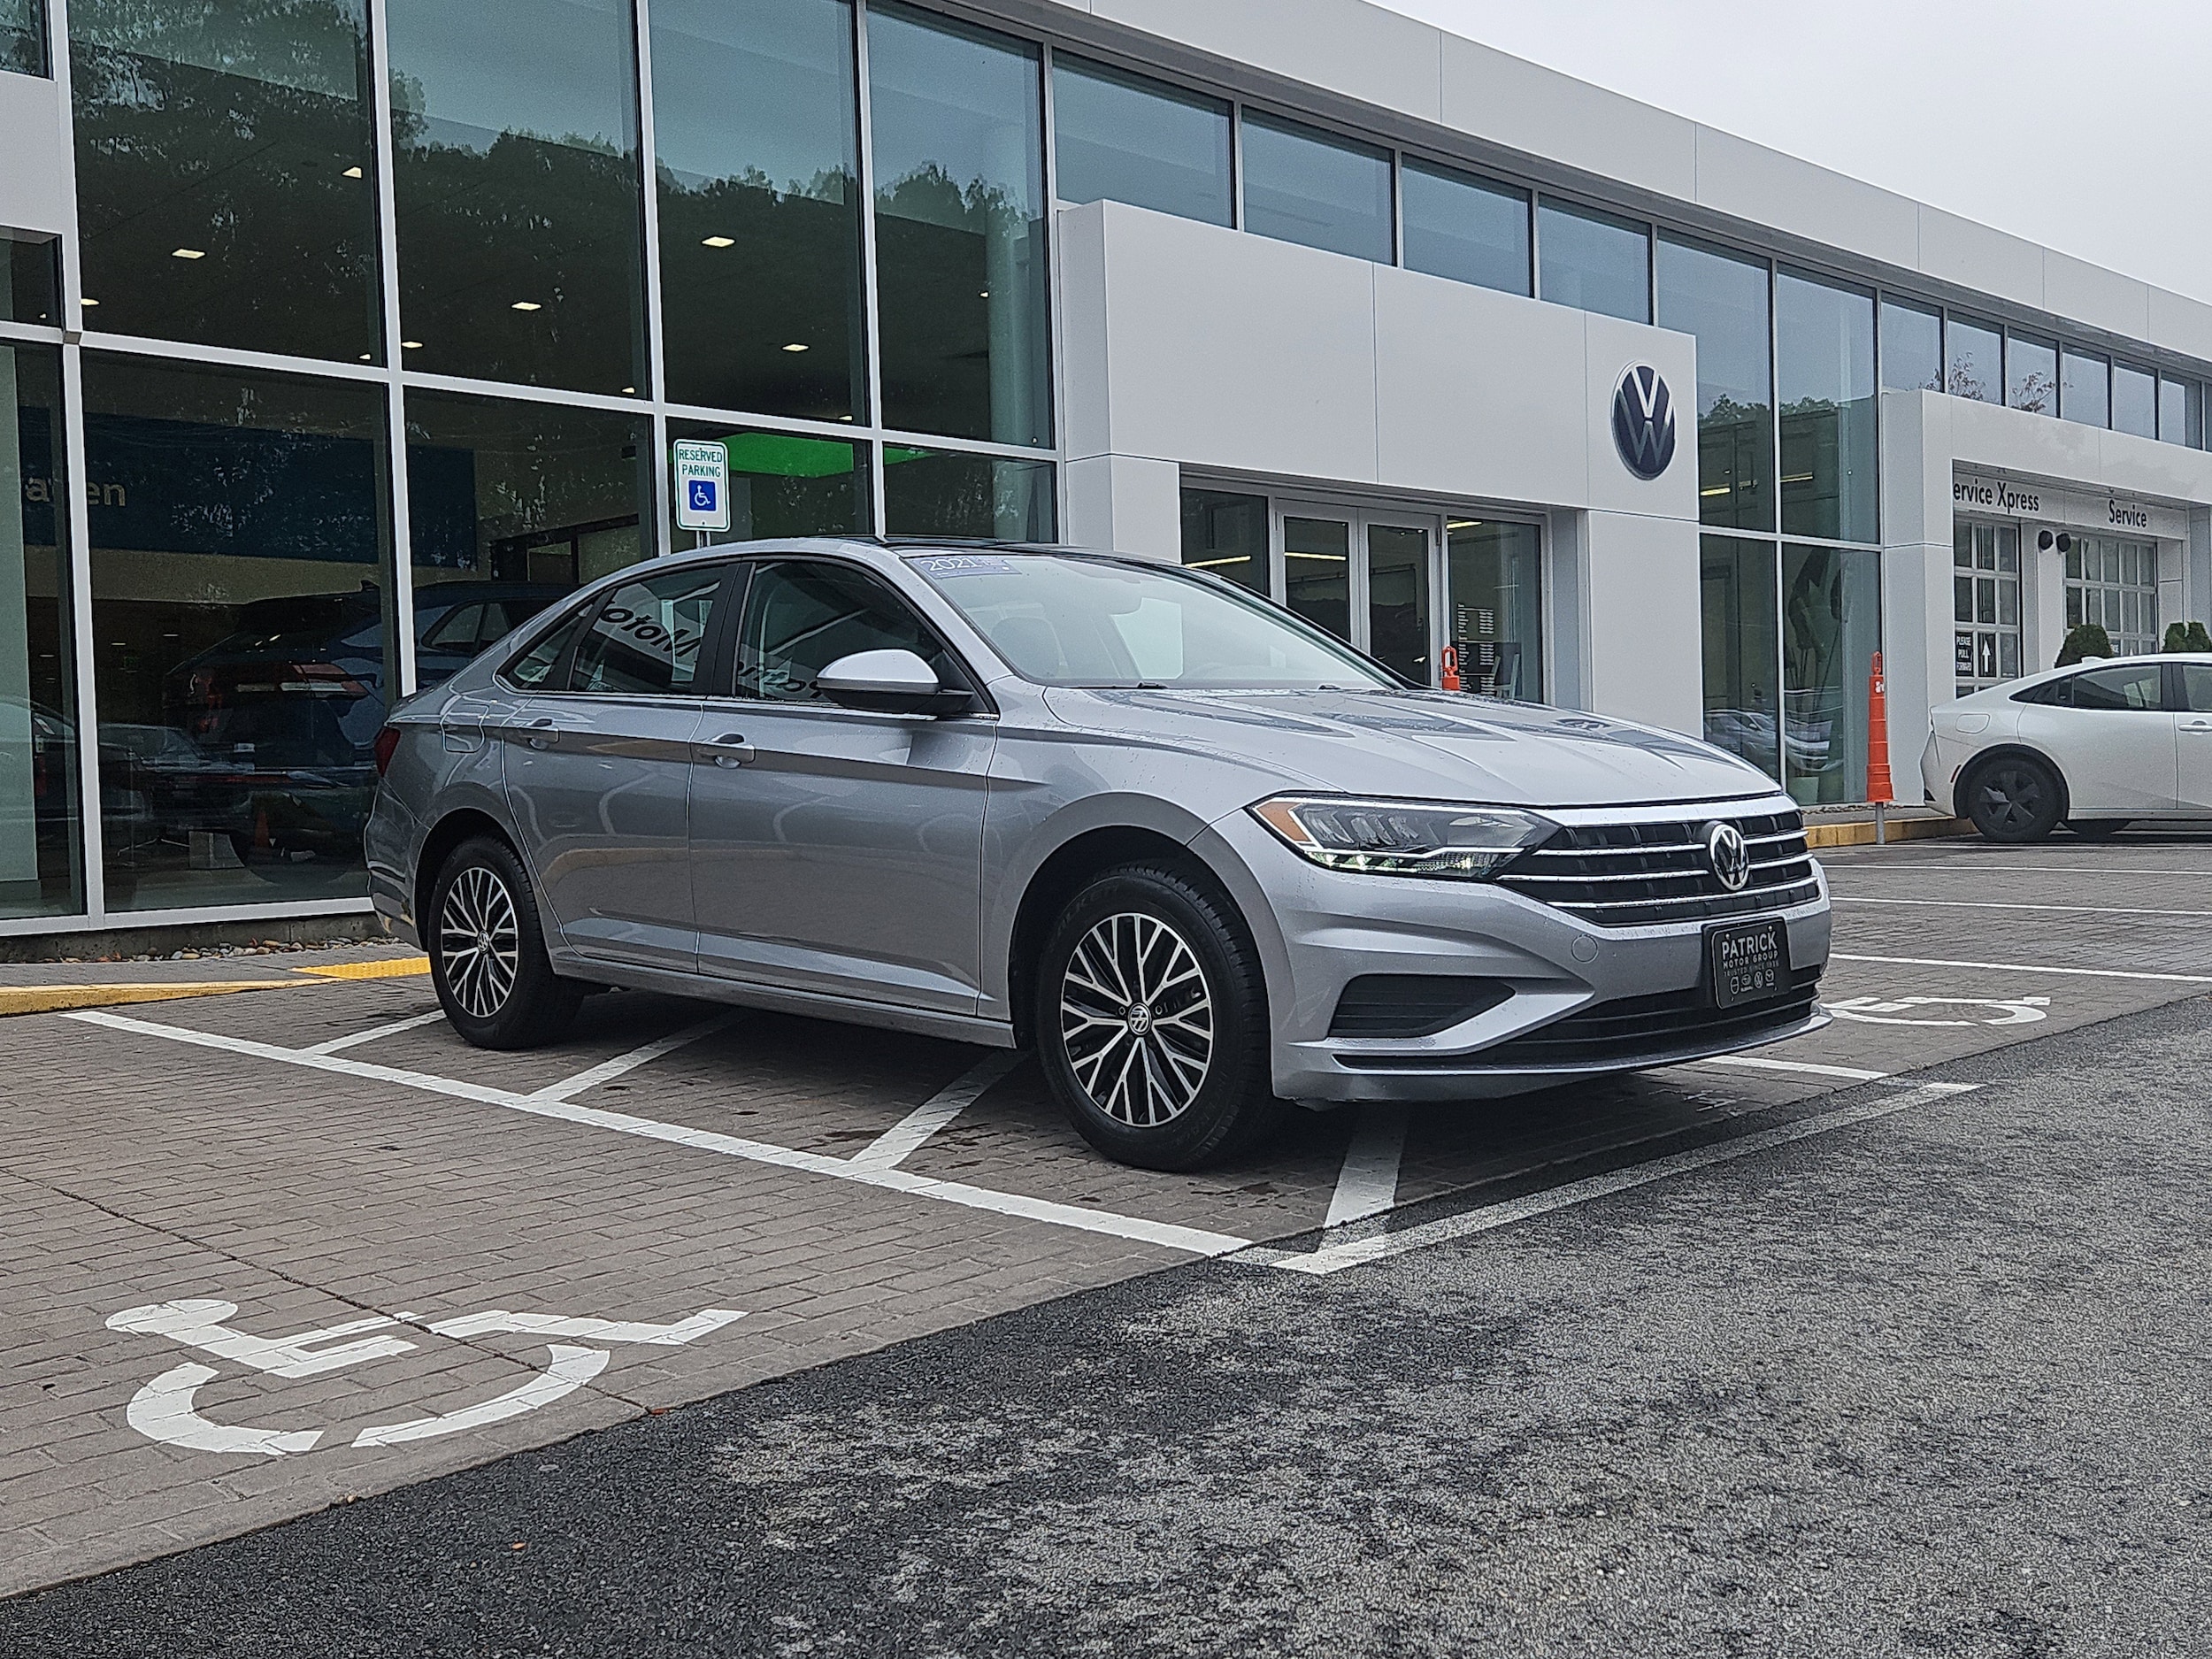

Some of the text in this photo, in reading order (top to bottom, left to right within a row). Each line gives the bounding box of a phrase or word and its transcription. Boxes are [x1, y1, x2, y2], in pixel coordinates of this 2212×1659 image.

[679, 449, 723, 462] RESERVED
[681, 465, 721, 478] PARKING
[1953, 478, 2039, 514] ervice Xpress
[2108, 499, 2147, 528] Service
[920, 557, 983, 572] 2021
[1721, 931, 1778, 961] PATRICK
[1723, 949, 1778, 970] MOTOR GROUP
